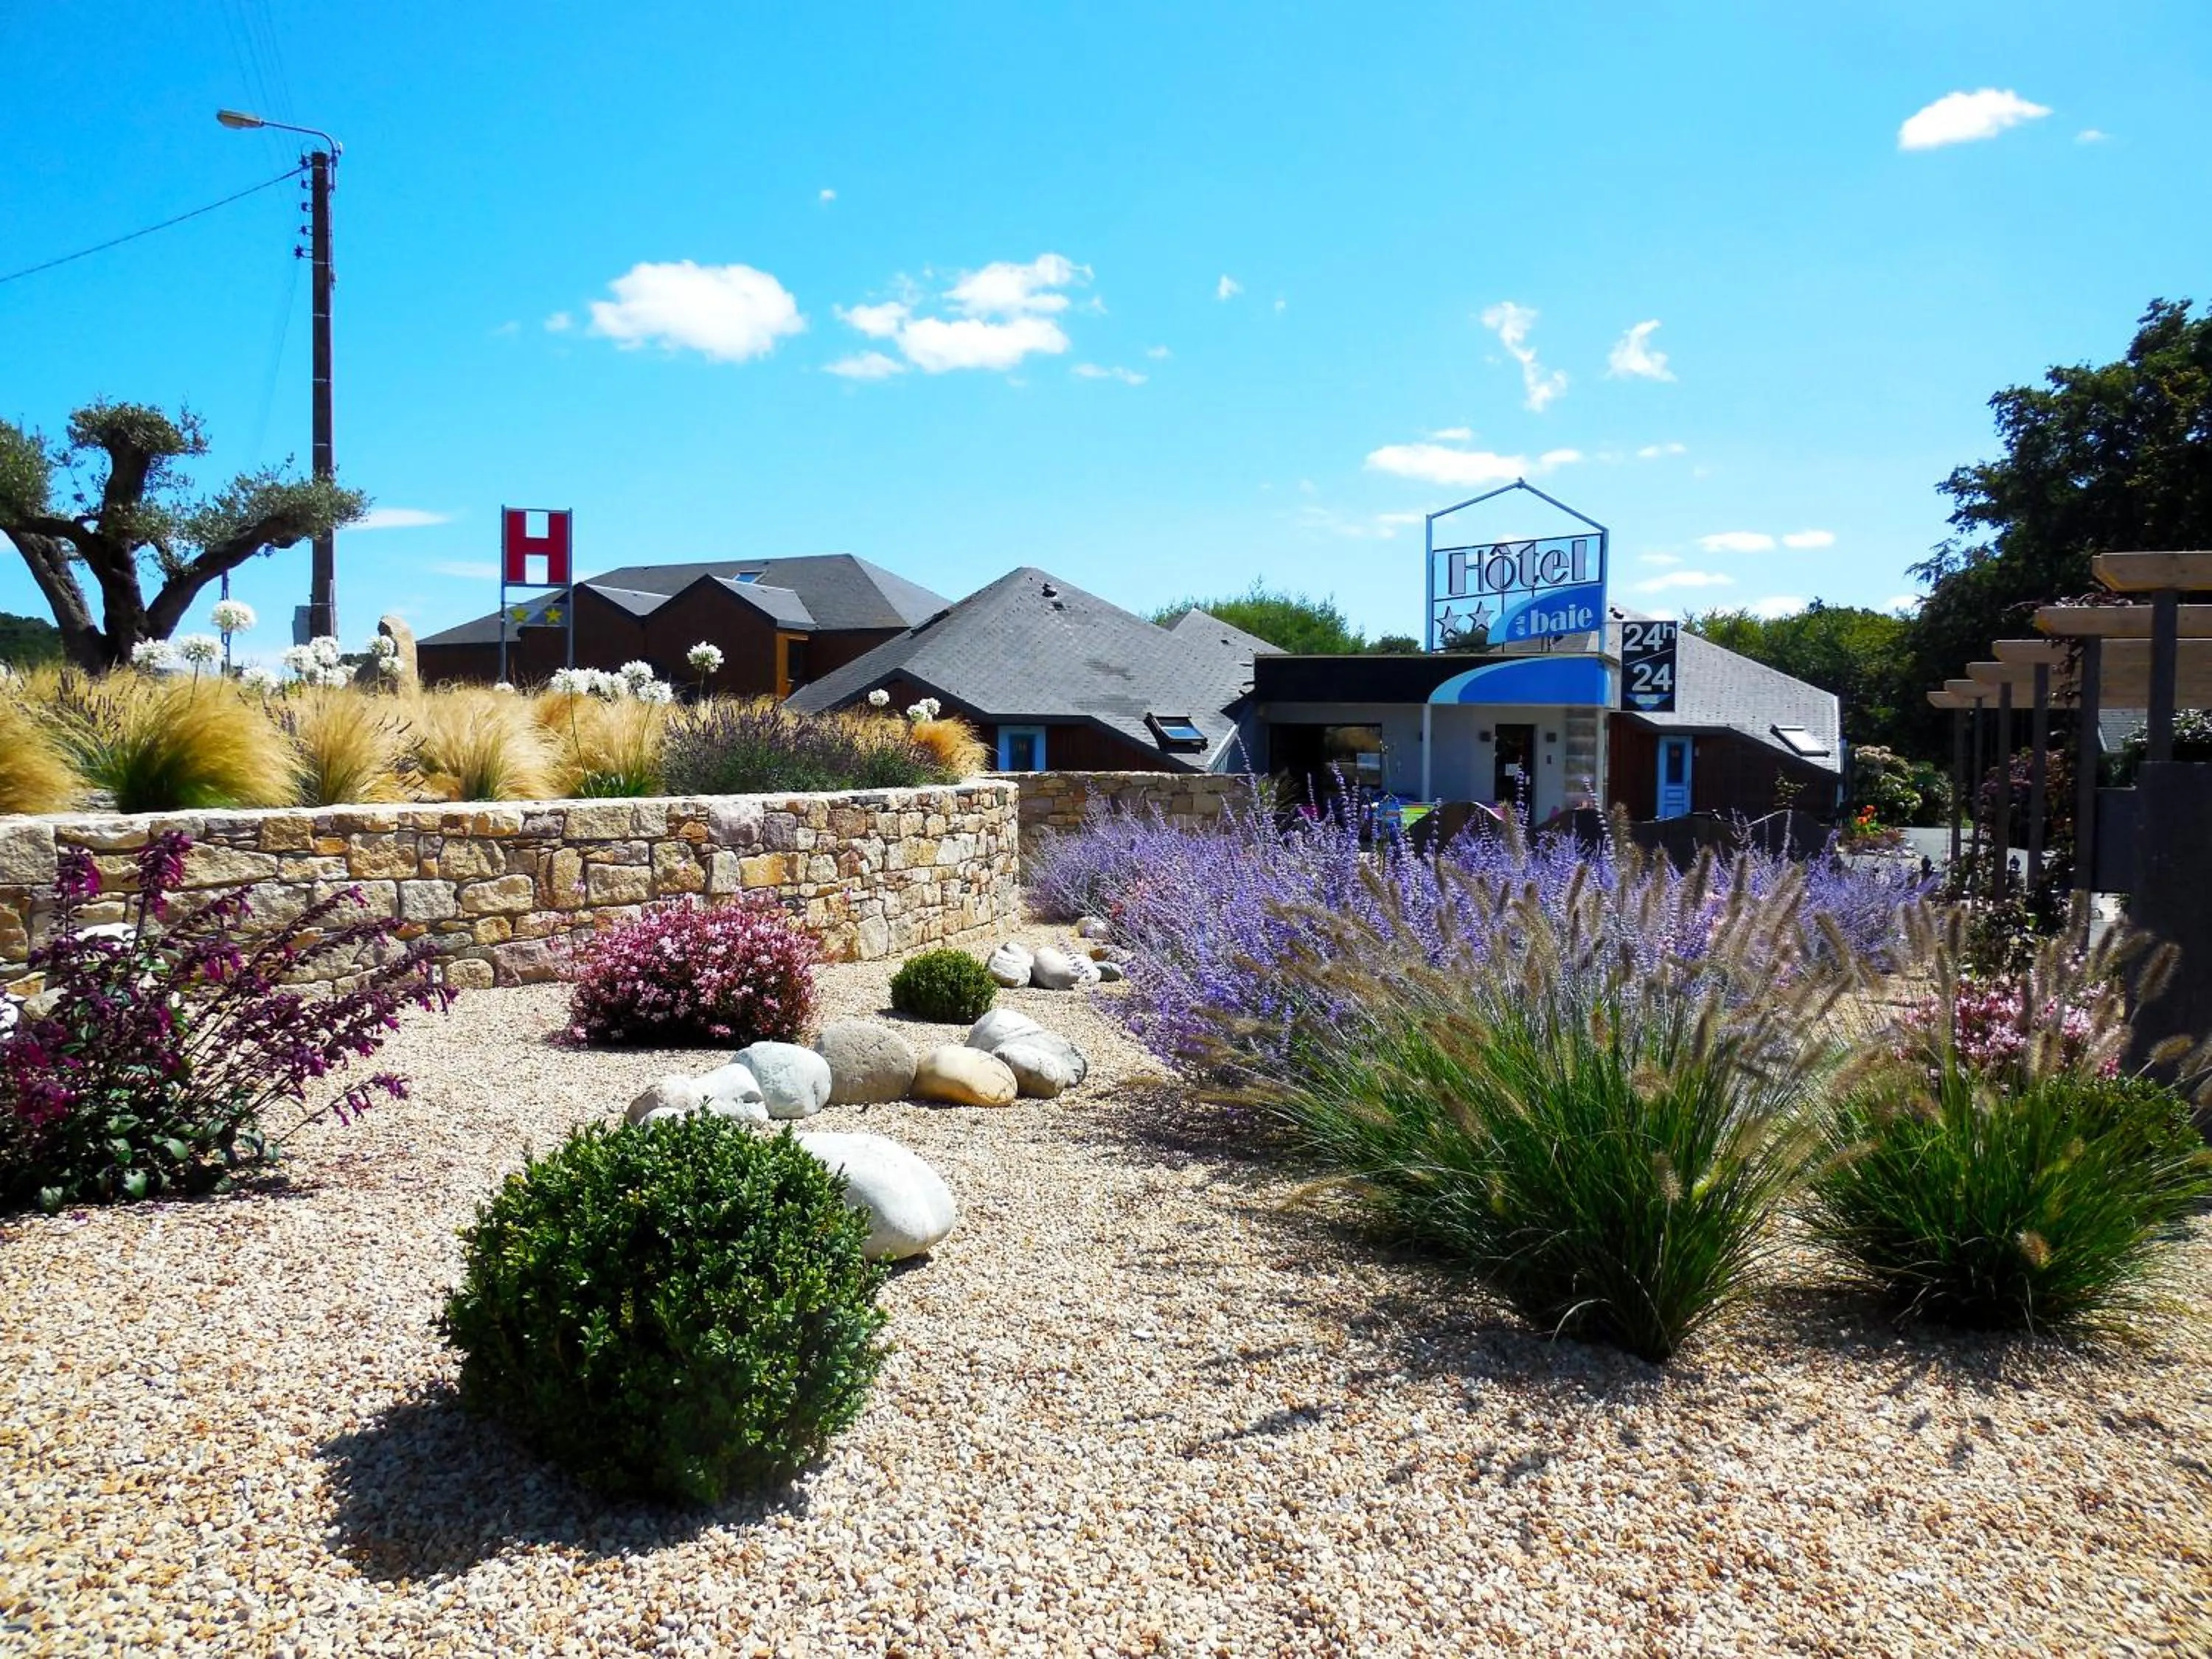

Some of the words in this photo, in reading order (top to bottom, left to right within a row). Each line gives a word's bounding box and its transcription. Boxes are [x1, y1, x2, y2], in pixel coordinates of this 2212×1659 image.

[506, 510, 568, 583] H
[1448, 540, 1587, 596] Hôtel
[1530, 604, 1593, 635] baie
[1623, 622, 1676, 651] 24h
[1632, 663, 1672, 691] 24
